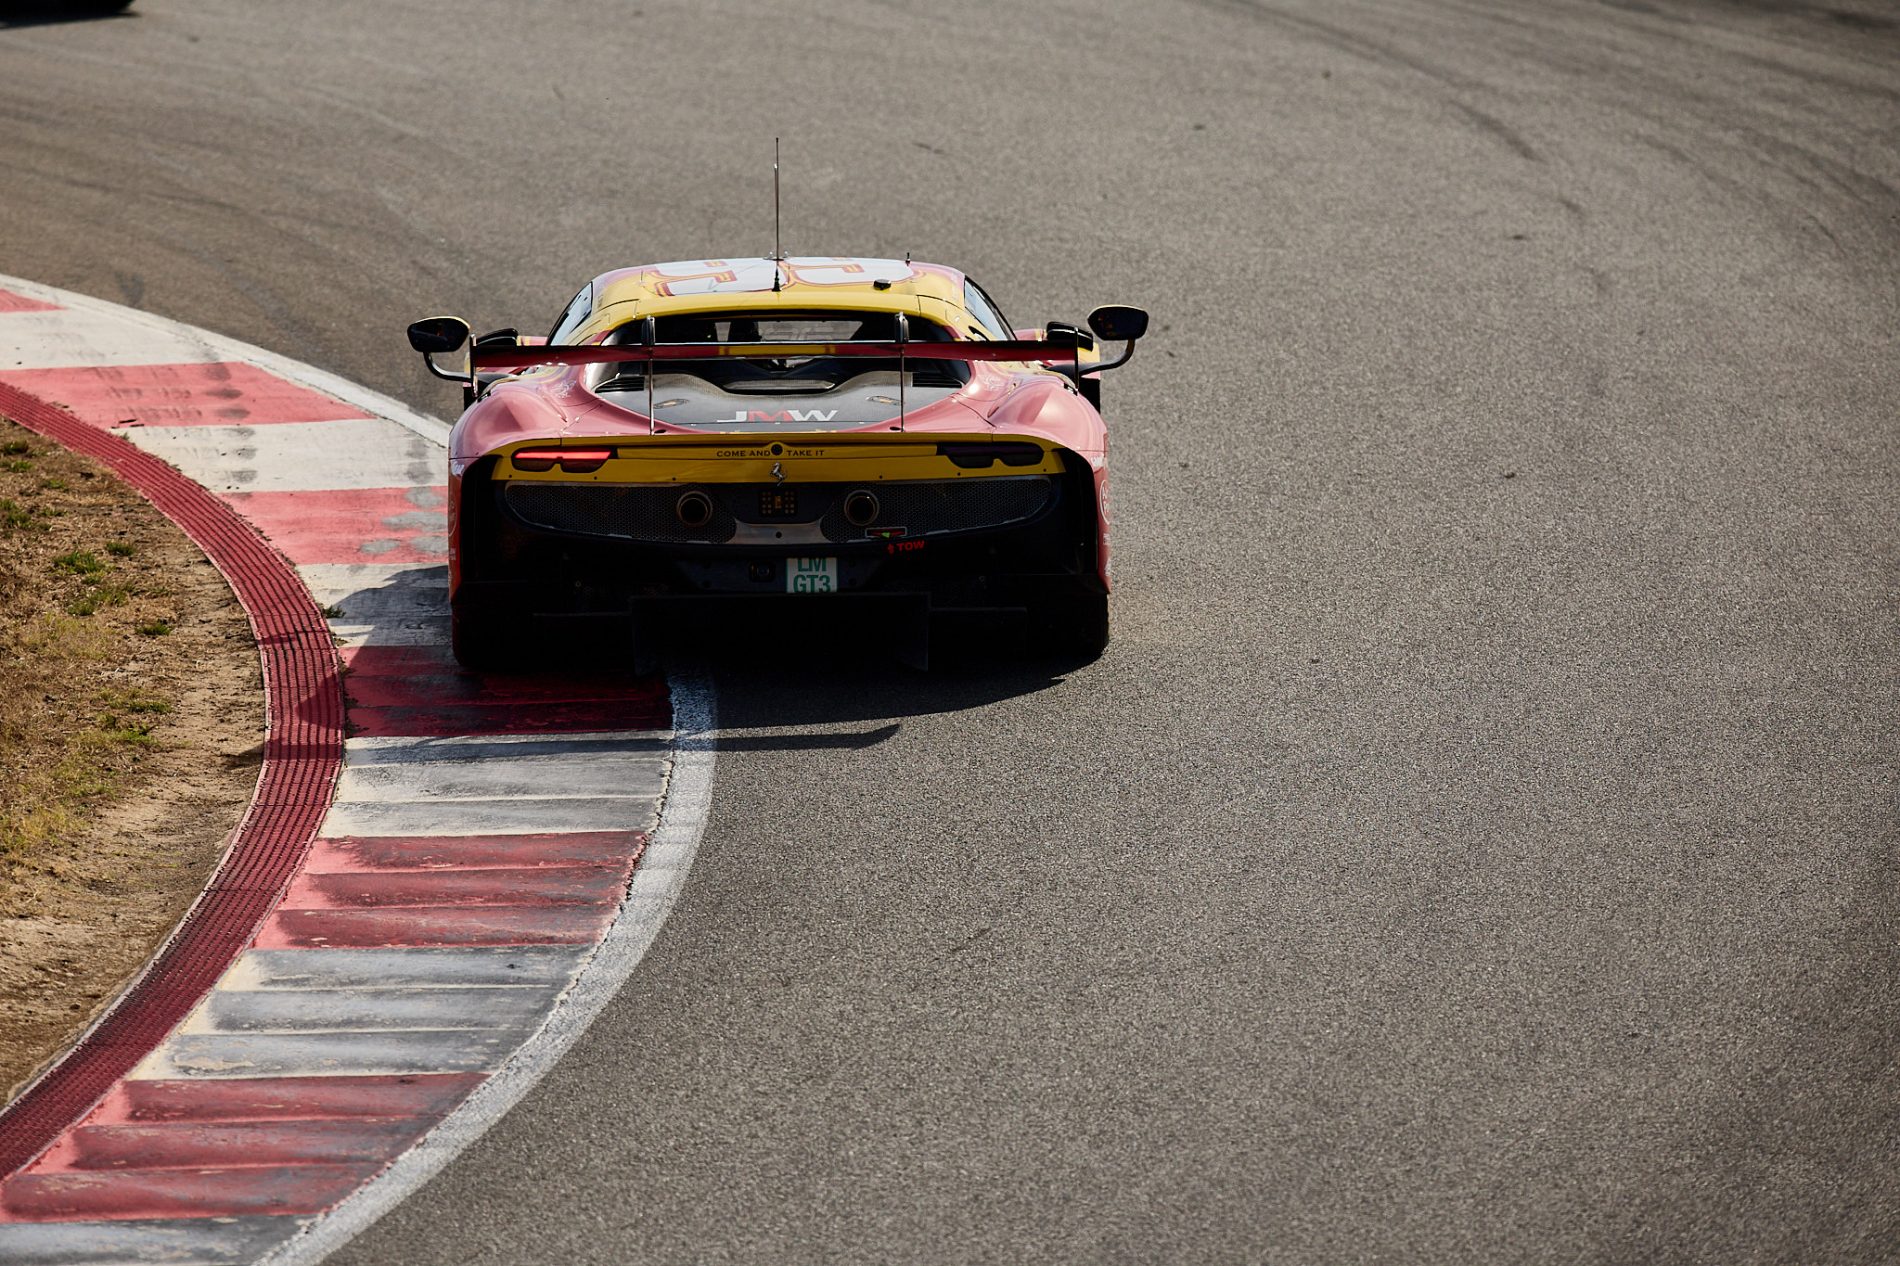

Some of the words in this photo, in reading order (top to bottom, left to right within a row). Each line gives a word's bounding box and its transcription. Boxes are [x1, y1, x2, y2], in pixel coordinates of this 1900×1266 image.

[717, 409, 838, 422] JMW
[787, 449, 812, 457] TAKE
[815, 449, 825, 457] IT
[898, 540, 925, 551] TOW
[798, 557, 826, 571] LM
[794, 574, 830, 593] GT3
